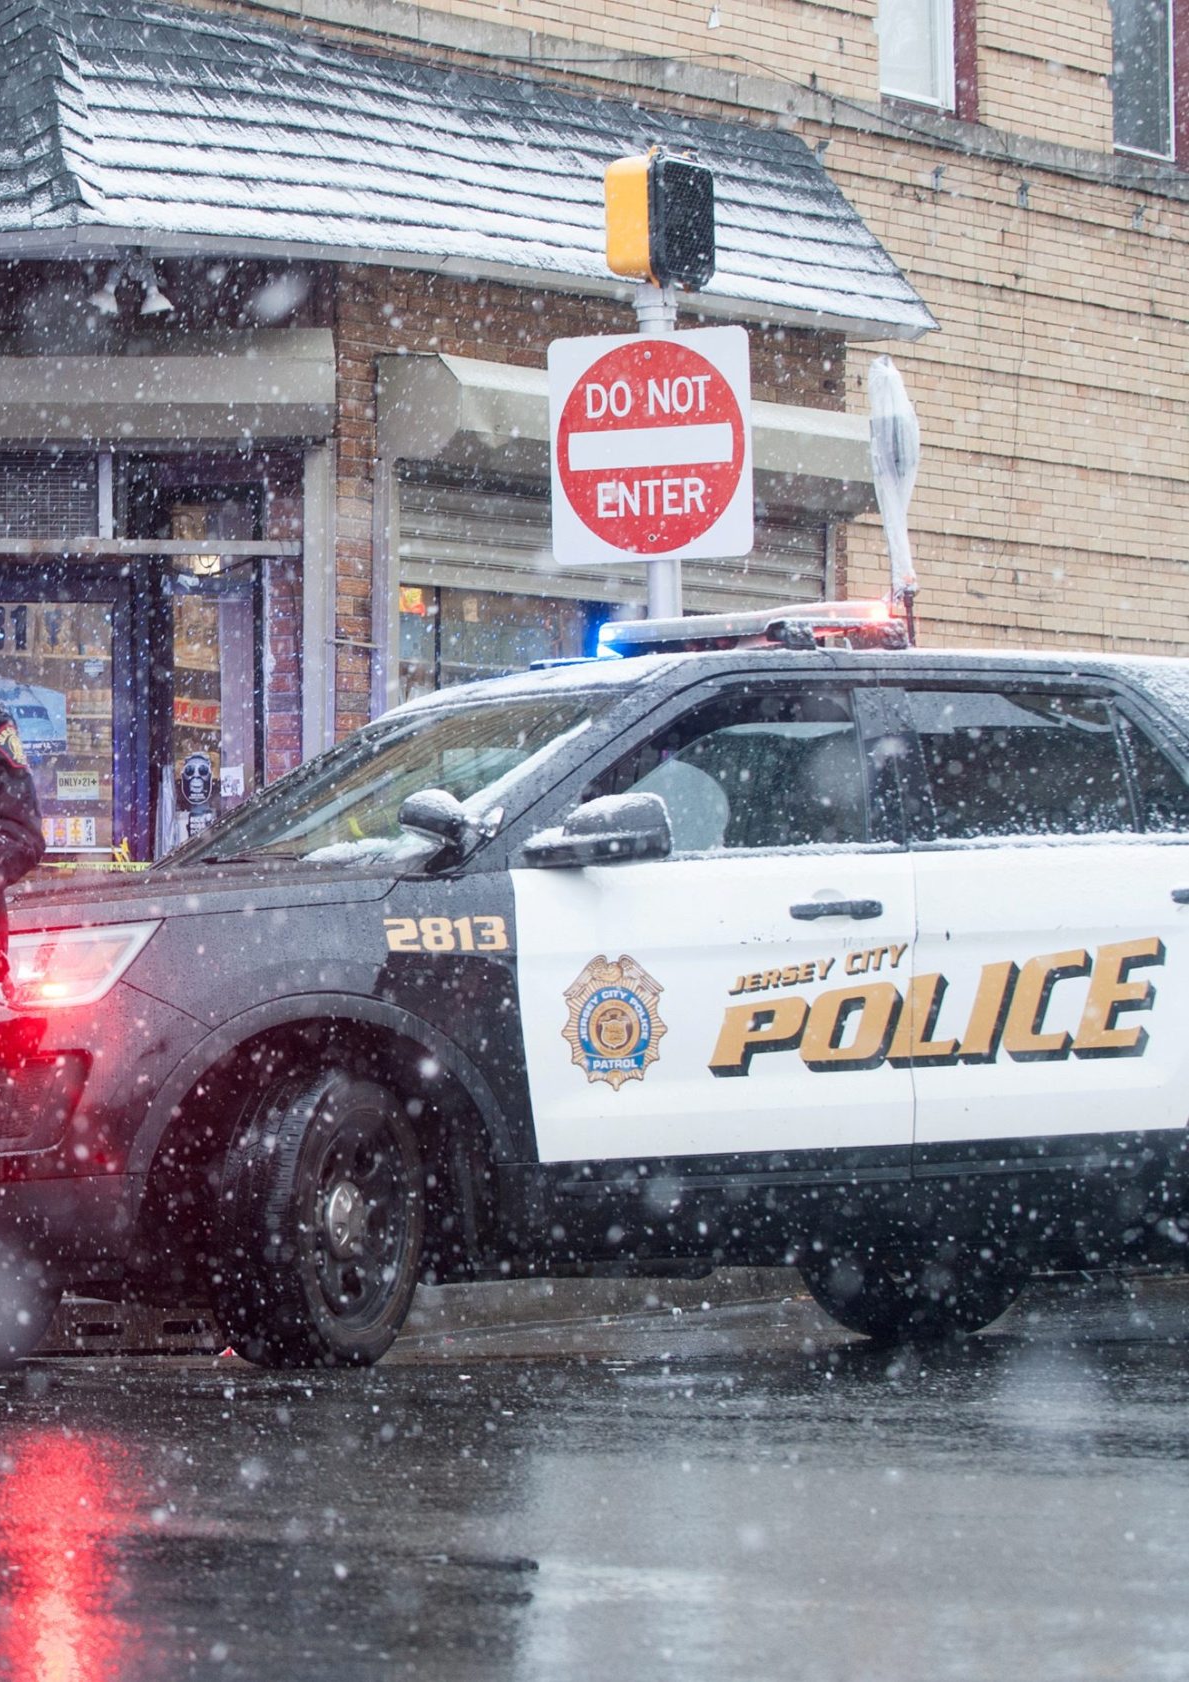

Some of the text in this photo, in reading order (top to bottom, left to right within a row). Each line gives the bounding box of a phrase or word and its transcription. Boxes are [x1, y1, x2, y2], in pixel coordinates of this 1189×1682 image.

[586, 375, 711, 419] DO NOT
[597, 477, 706, 518] ENTER
[59, 777, 77, 787] ONLY
[383, 915, 508, 951] 2813
[727, 943, 908, 995] JERSEY CITY
[580, 989, 650, 1042] JERSEY CITY POLICE
[708, 936, 1166, 1078] POLICE
[592, 1058, 639, 1070] PATROL
